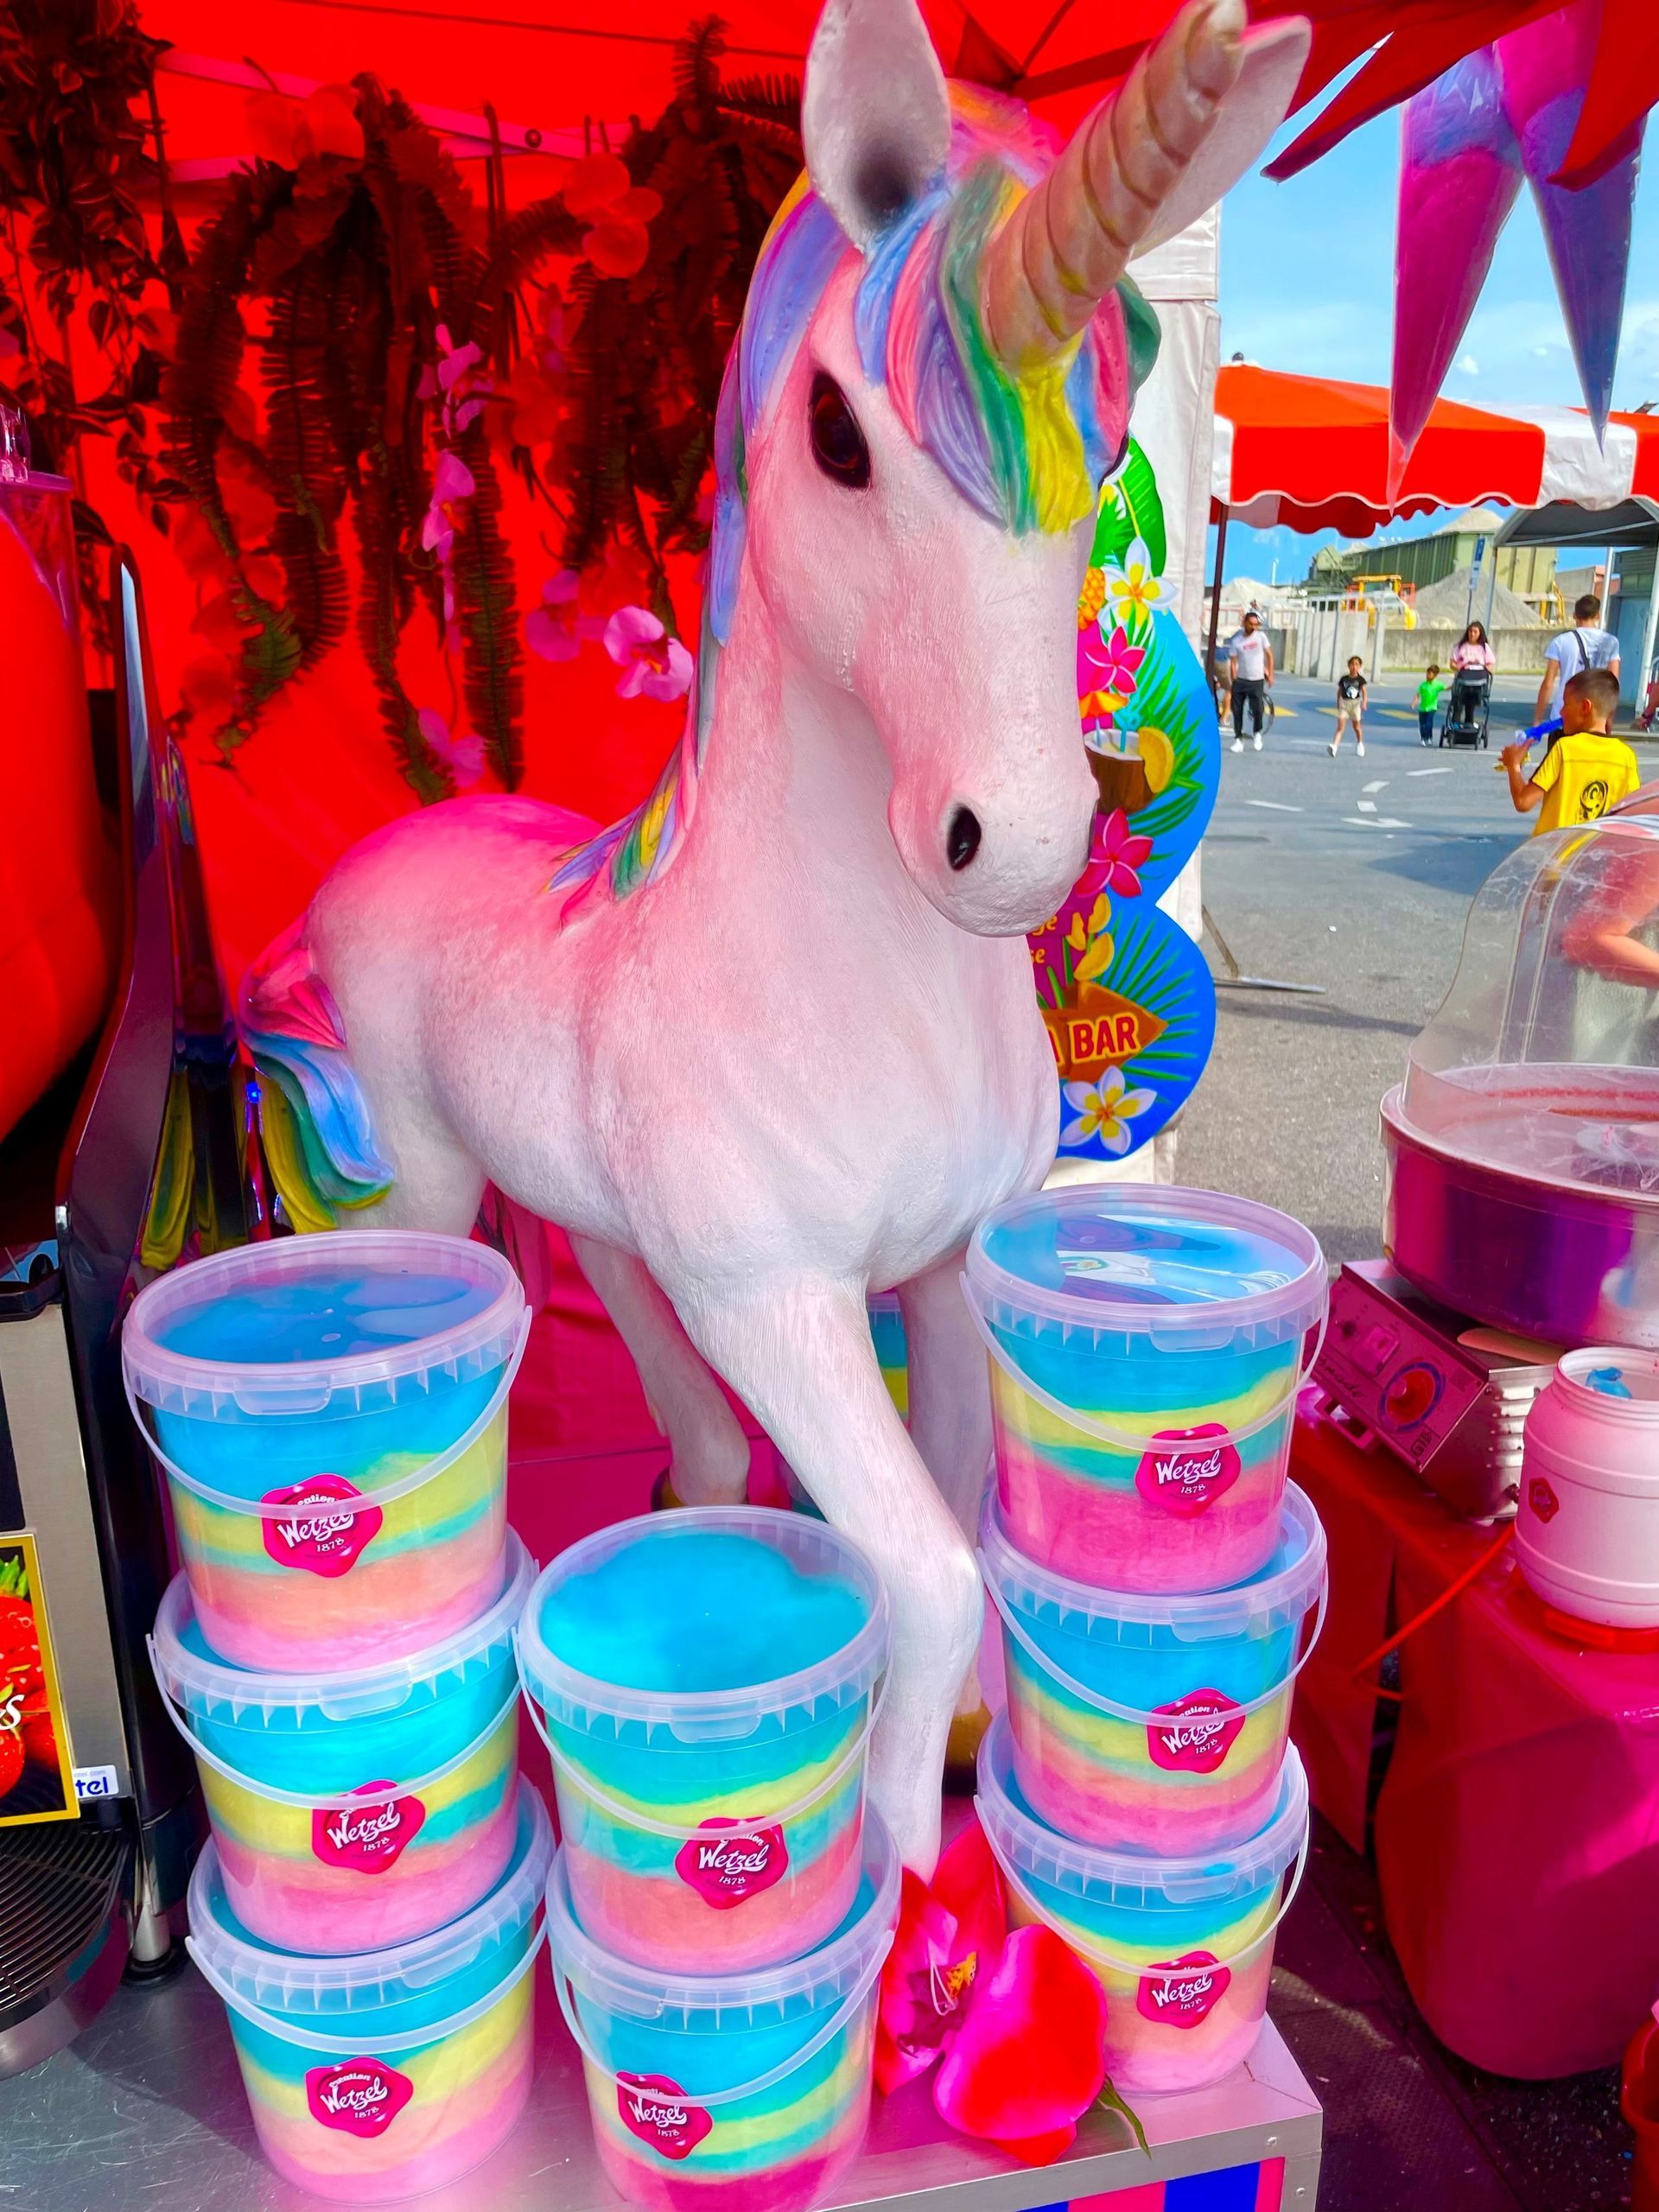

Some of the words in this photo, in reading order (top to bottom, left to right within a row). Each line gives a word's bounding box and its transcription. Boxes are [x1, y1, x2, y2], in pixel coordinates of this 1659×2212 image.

[1070, 1013, 1141, 1063] BAR
[1154, 1449, 1222, 1484] Wetzel
[1180, 1484, 1206, 1495] 1878
[296, 1494, 337, 1506] eation
[316, 1537, 345, 1552] 1878
[1179, 1706, 1211, 1718] eation
[1195, 1738, 1218, 1754] 1878
[74, 1776, 109, 1797] tel
[327, 1802, 401, 1849] Wetzel
[363, 1837, 391, 1852] 1878
[698, 1840, 770, 1875] Wetzel
[718, 1876, 747, 1885] 1878
[1151, 1974, 1213, 2008] Wetzel
[320, 2076, 388, 2114] Wetzel
[354, 2107, 380, 2119] 1878
[627, 2096, 688, 2128] Wetzel
